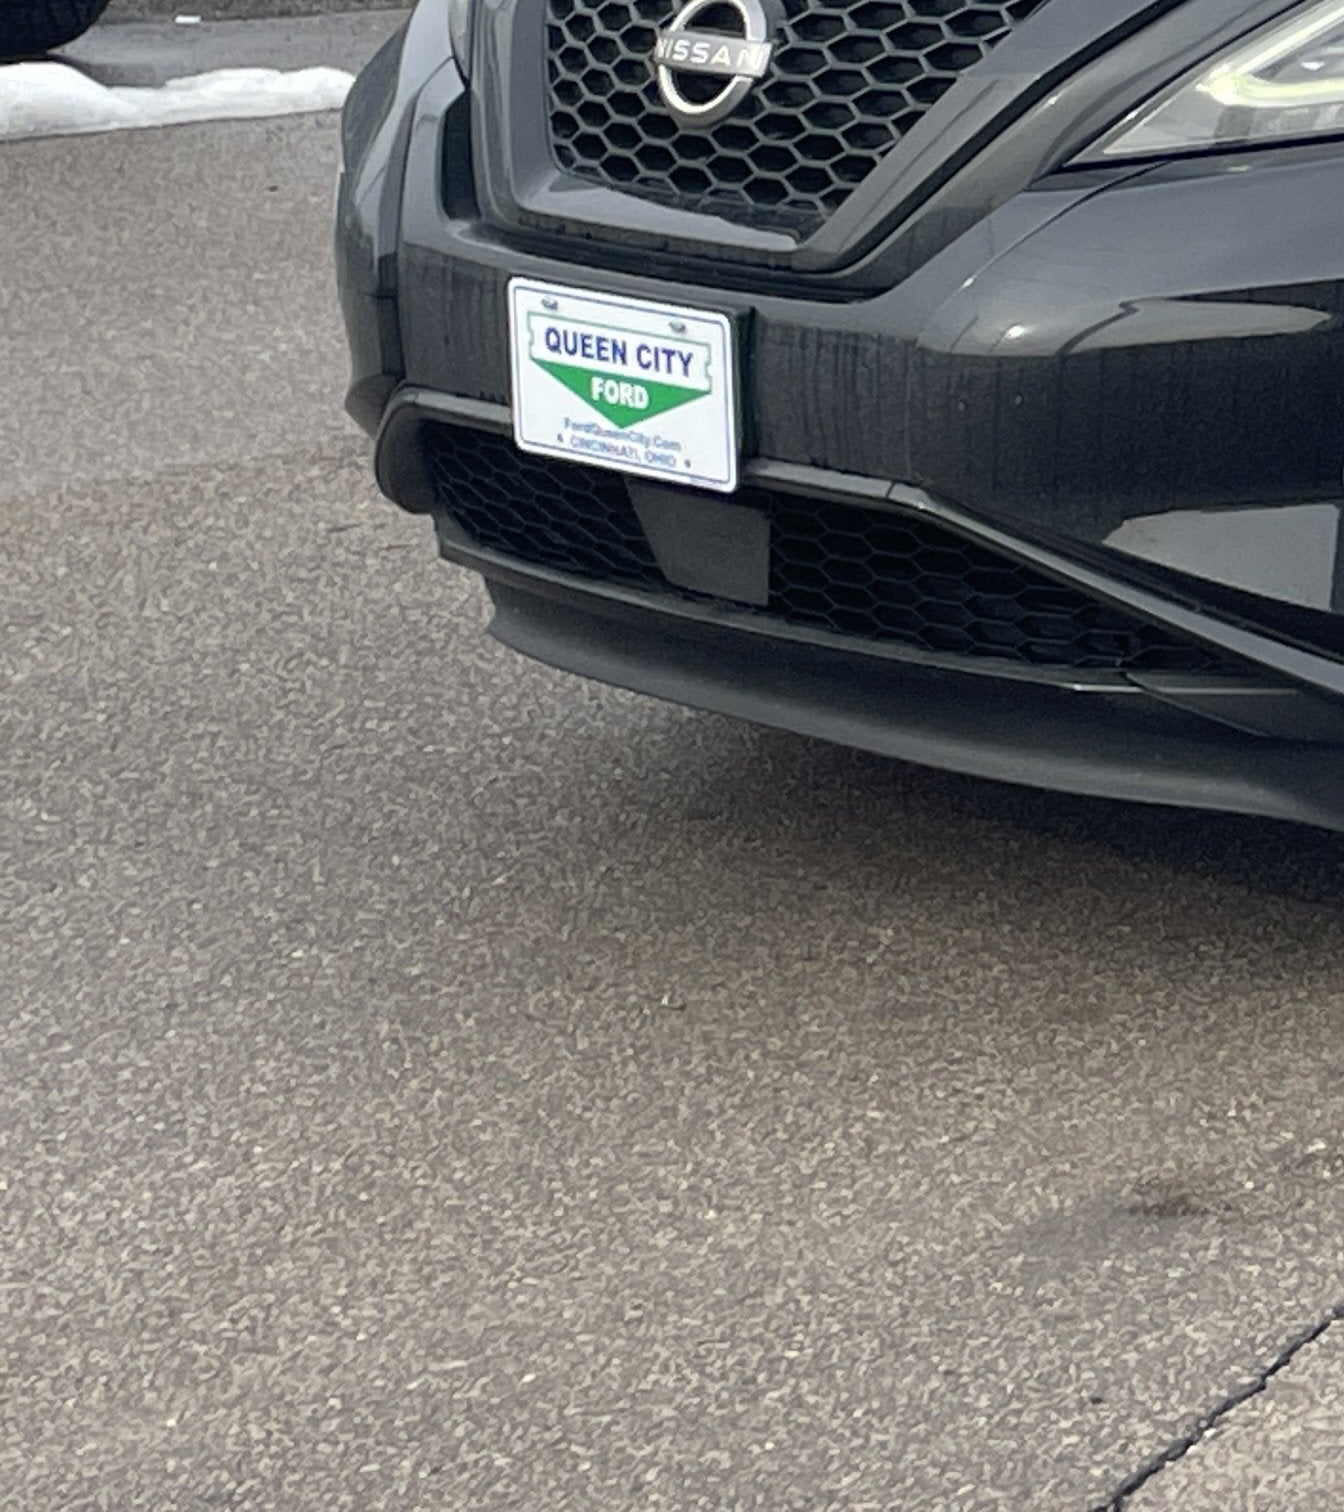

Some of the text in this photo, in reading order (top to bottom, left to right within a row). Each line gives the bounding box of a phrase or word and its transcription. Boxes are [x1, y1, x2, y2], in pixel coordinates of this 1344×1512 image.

[656, 37, 765, 72] NISSAN
[544, 327, 694, 378] QUEEN CITY
[590, 377, 649, 410] FORD
[644, 449, 677, 468] OHIO
